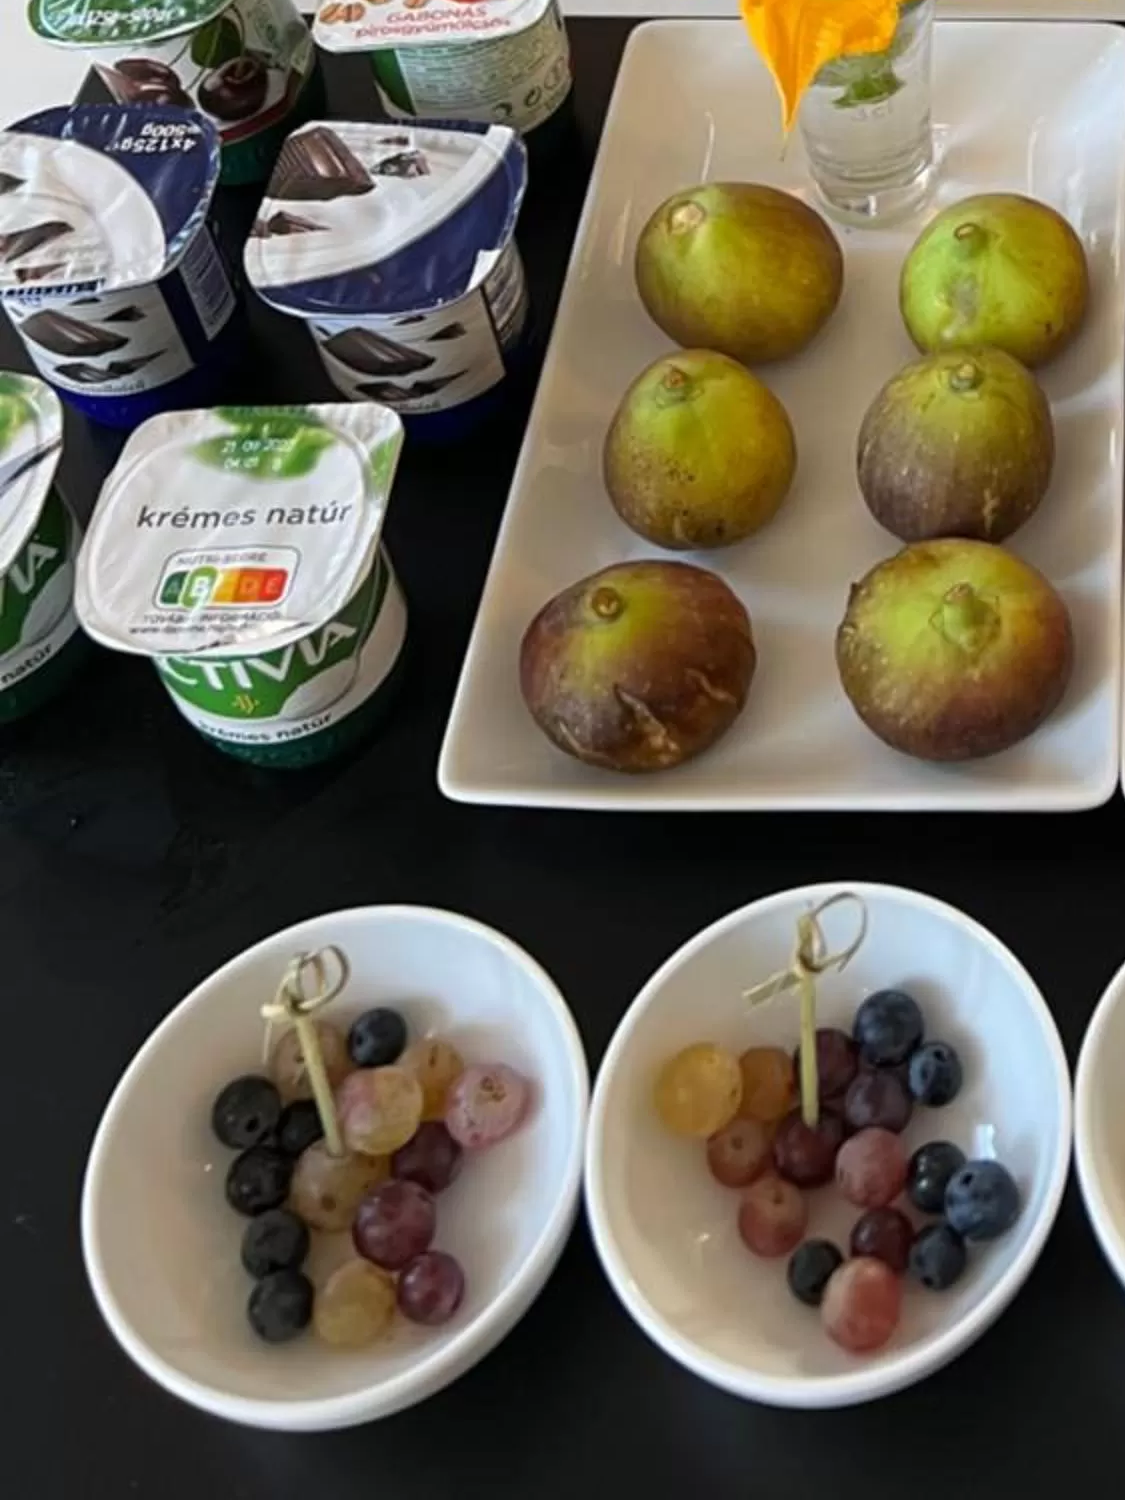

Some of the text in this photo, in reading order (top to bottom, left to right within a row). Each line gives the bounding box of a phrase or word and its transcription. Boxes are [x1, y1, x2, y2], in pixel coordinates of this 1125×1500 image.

[136, 500, 352, 529] krémes natúr
[163, 621, 357, 691] CTIVIA
